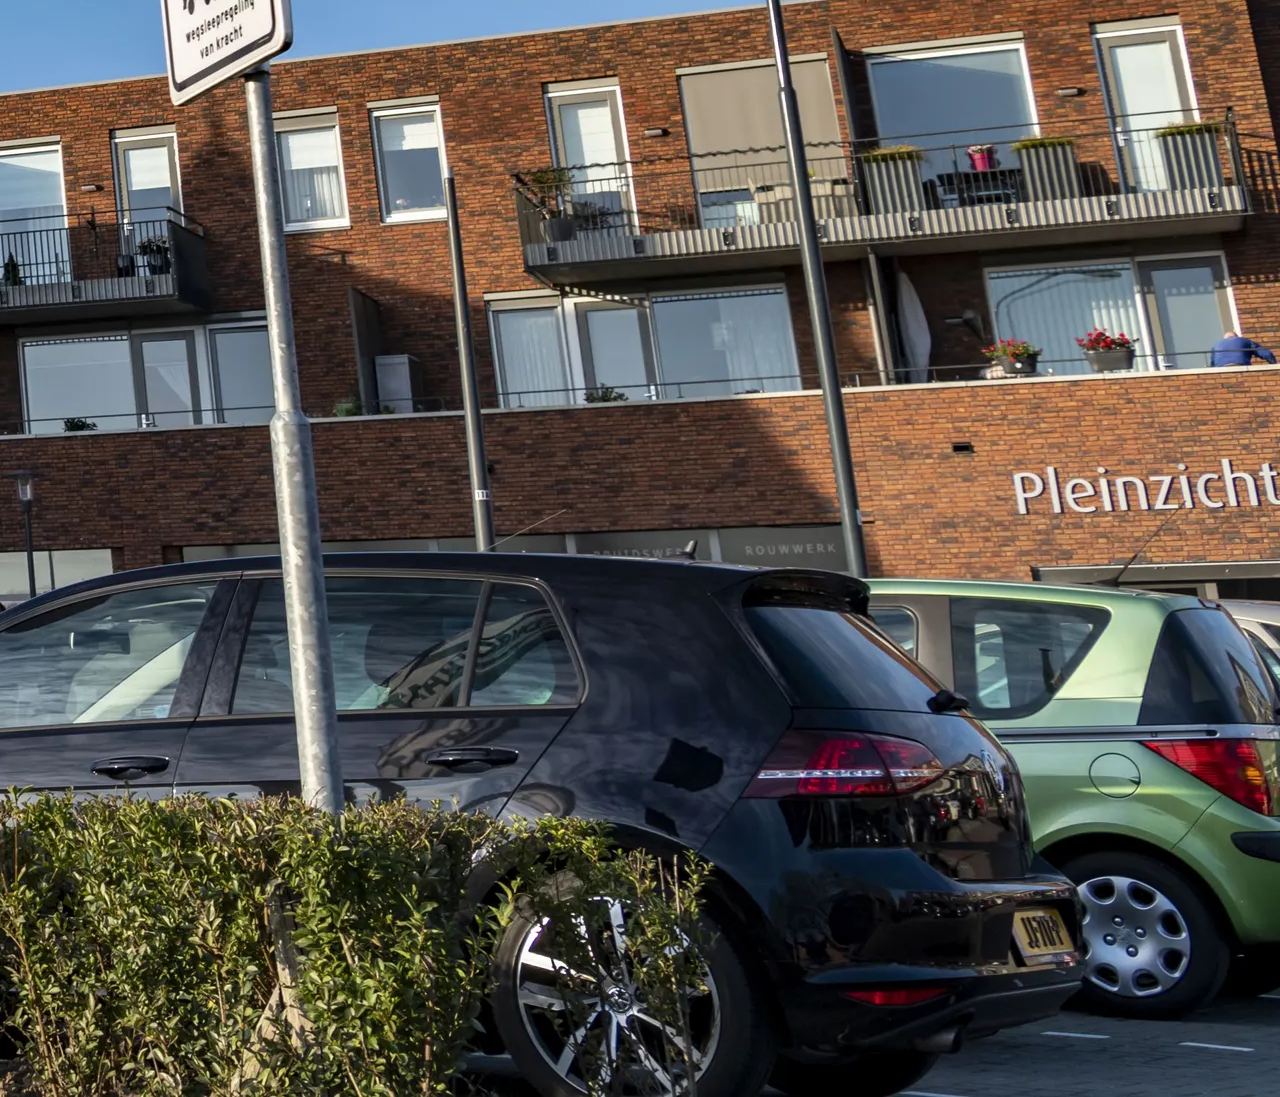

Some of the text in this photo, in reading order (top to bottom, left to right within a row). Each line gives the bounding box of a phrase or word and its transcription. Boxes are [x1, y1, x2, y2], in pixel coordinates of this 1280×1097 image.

[199, 42, 215, 60] van
[216, 24, 243, 49] kracht
[1013, 458, 1280, 515] Pleinzicht
[745, 543, 836, 556] ROUWWERK
